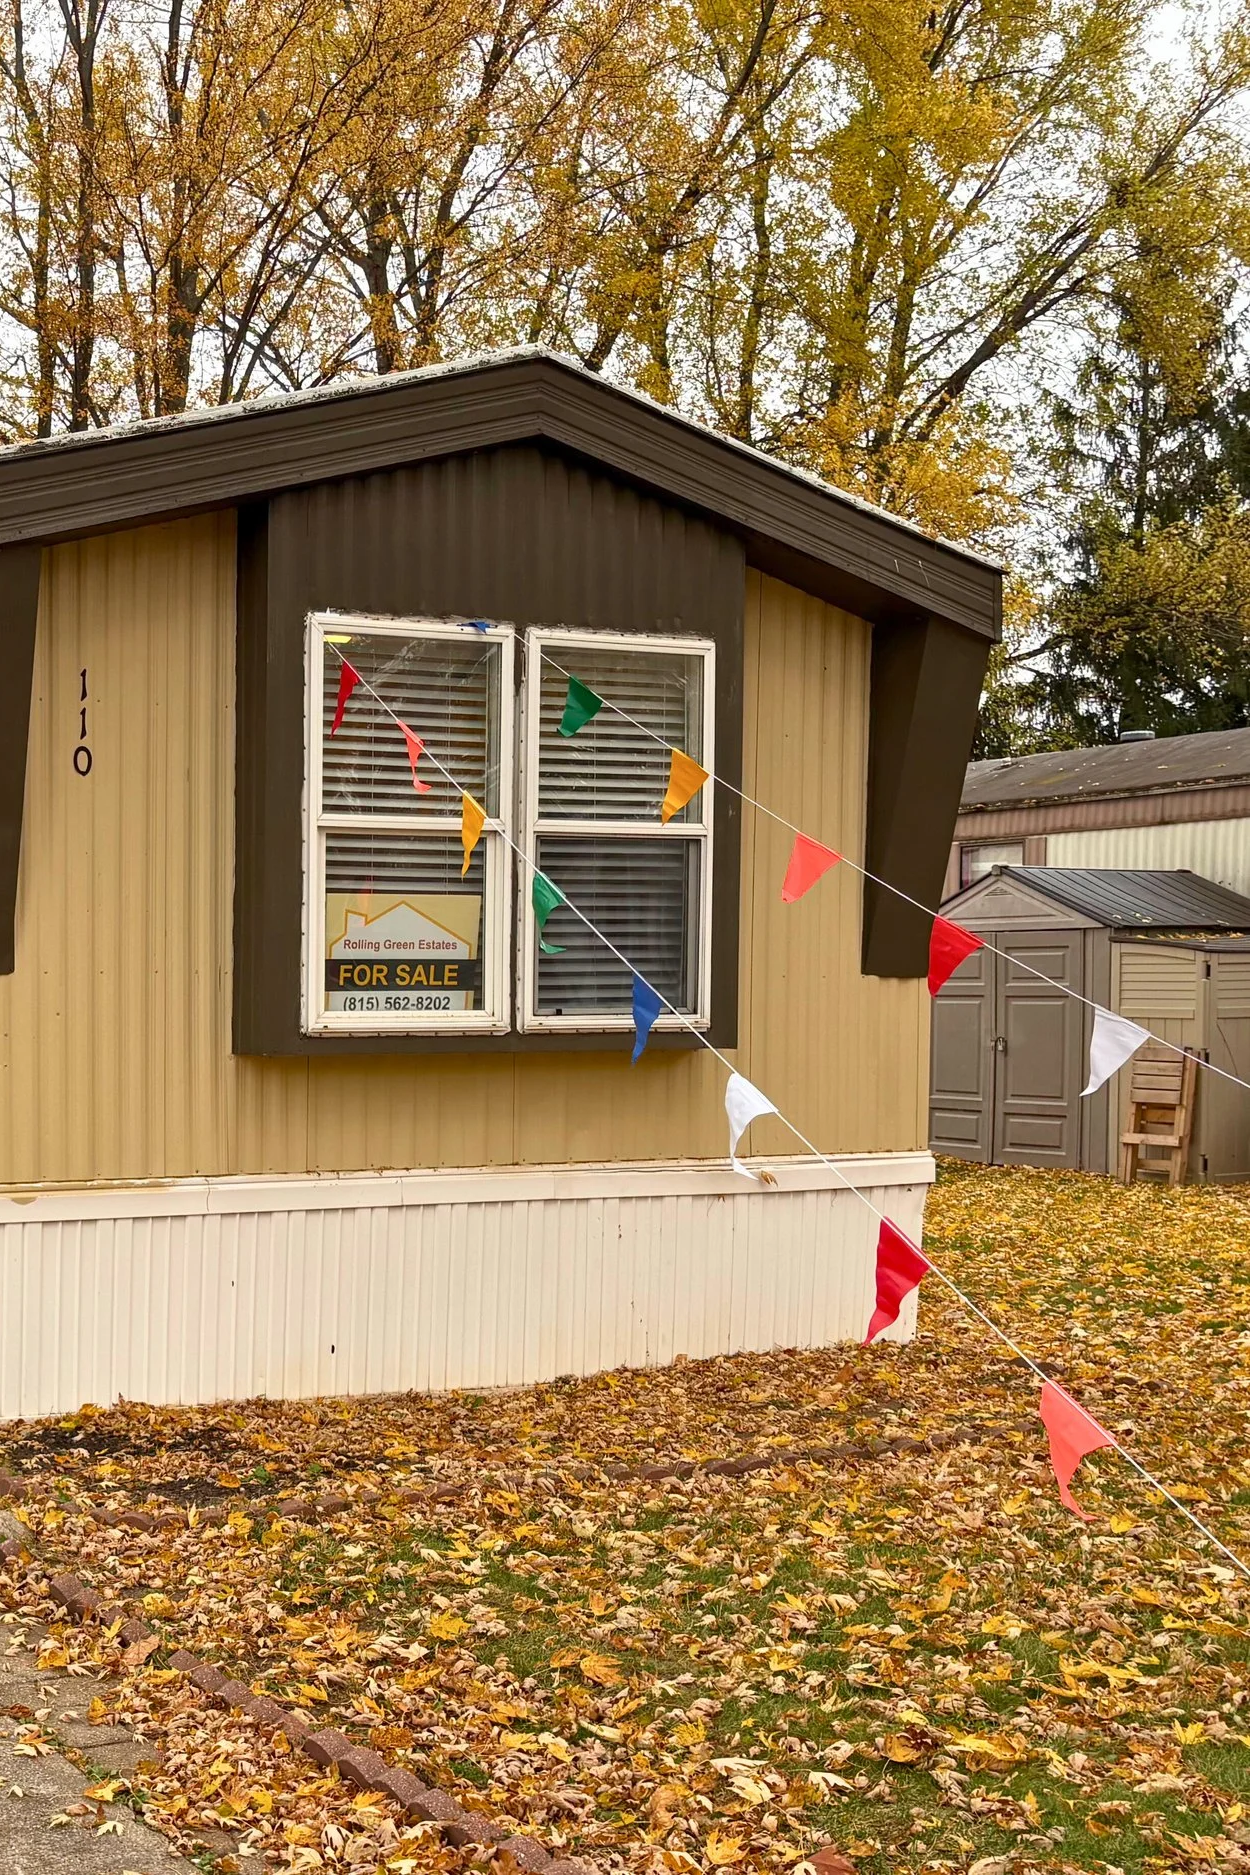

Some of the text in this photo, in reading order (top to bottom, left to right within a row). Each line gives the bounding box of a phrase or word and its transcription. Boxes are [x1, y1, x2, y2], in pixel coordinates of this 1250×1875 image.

[73, 668, 92, 776] 110
[343, 939, 458, 952] Rolling Green Estates
[338, 964, 459, 986] FOR SALE
[343, 996, 451, 1011] (815) 562-8202
